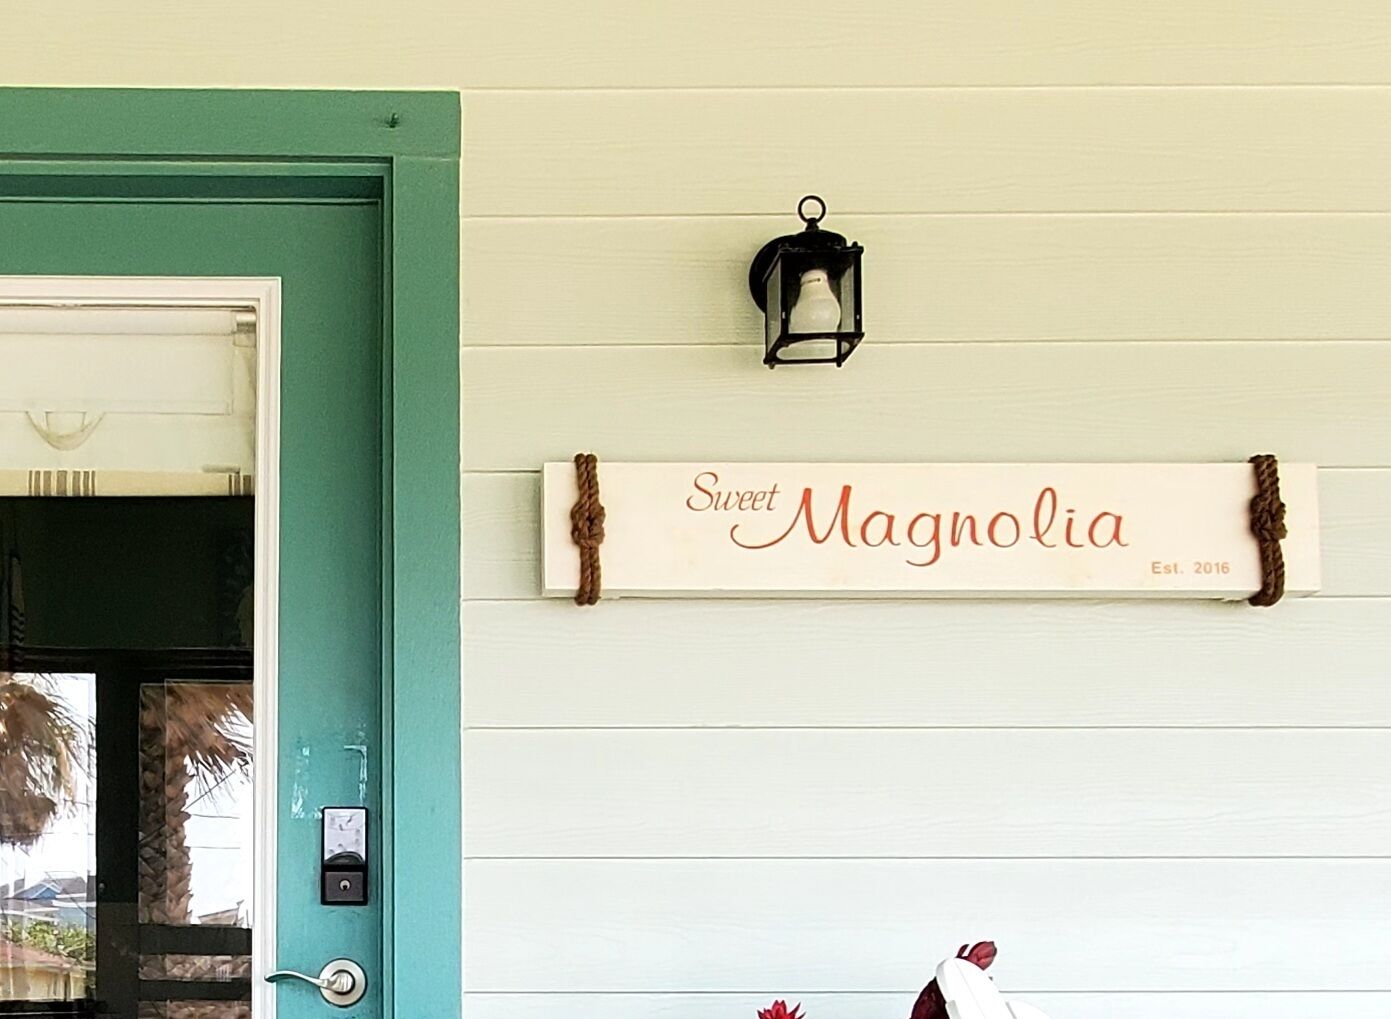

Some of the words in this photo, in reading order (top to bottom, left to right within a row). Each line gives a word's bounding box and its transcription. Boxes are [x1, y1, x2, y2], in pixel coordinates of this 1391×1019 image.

[686, 472, 781, 512] Sweet
[730, 485, 1129, 567] Magnolia
[1151, 561, 1184, 575] Est.
[1193, 561, 1231, 575] 2016
